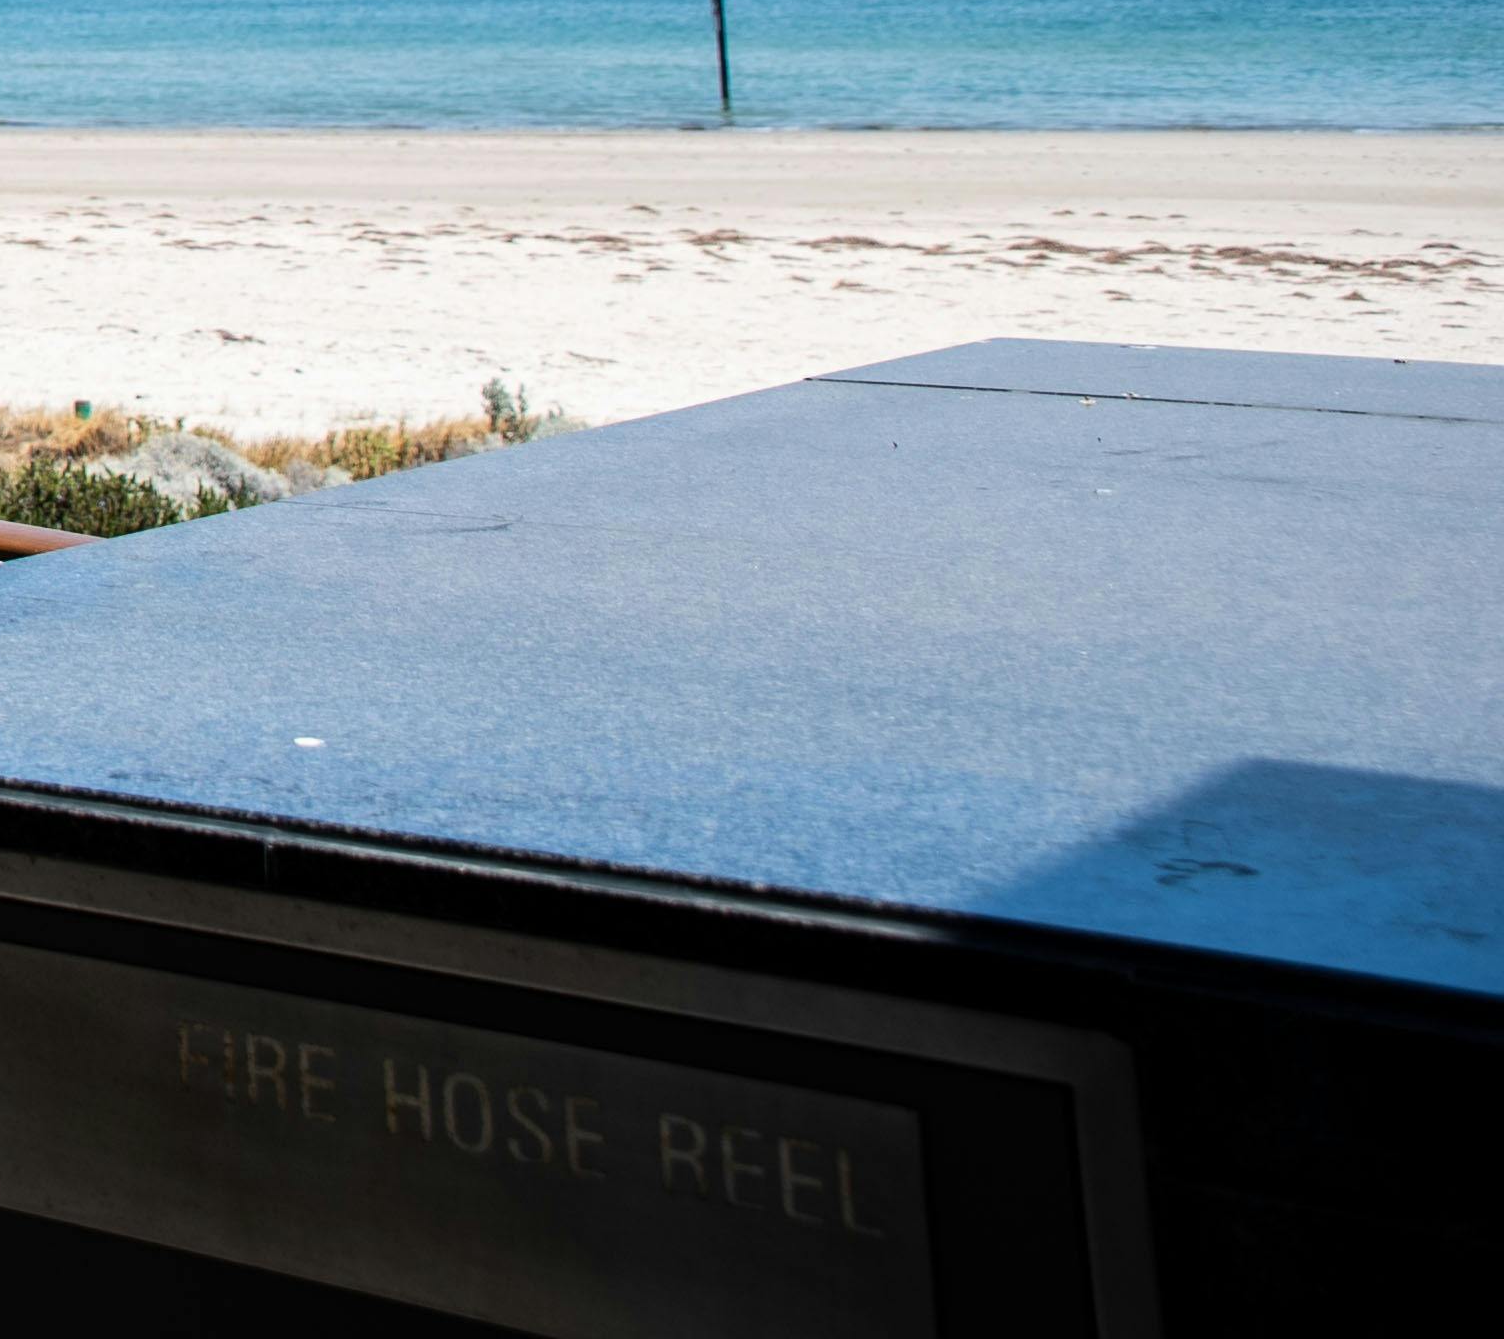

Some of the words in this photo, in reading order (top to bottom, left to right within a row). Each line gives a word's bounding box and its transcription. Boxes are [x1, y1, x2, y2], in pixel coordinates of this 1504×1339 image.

[174, 1018, 338, 1124] FIRE
[380, 1053, 607, 1182] HOSE
[657, 1110, 886, 1241] REEL
